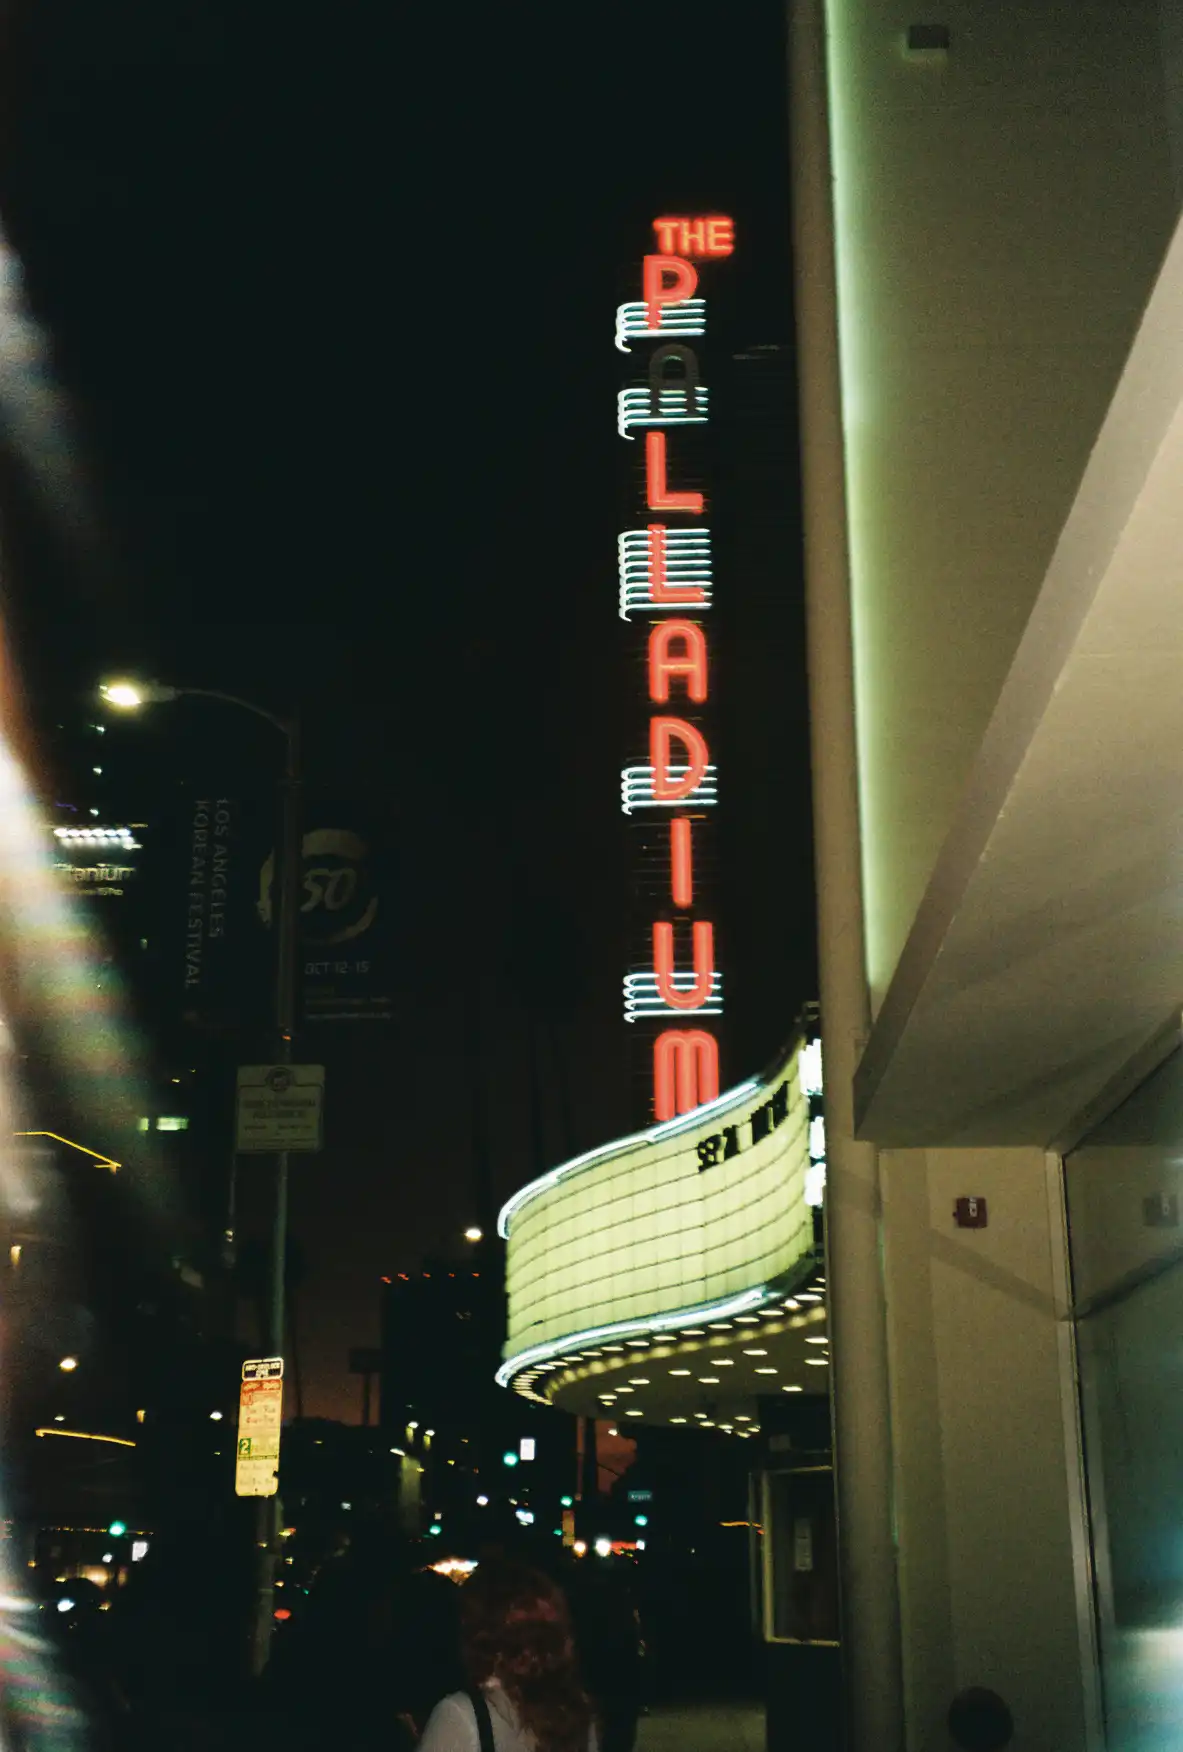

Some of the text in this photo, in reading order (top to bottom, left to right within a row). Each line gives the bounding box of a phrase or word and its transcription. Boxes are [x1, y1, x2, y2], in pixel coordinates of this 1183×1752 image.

[653, 217, 734, 255] THE
[643, 254, 718, 1121] PALLADIUM
[184, 799, 211, 988] KOREAN FESTIVAL
[208, 797, 231, 938] LOS ANGELES
[300, 867, 357, 913] 50
[304, 961, 331, 976] OCT
